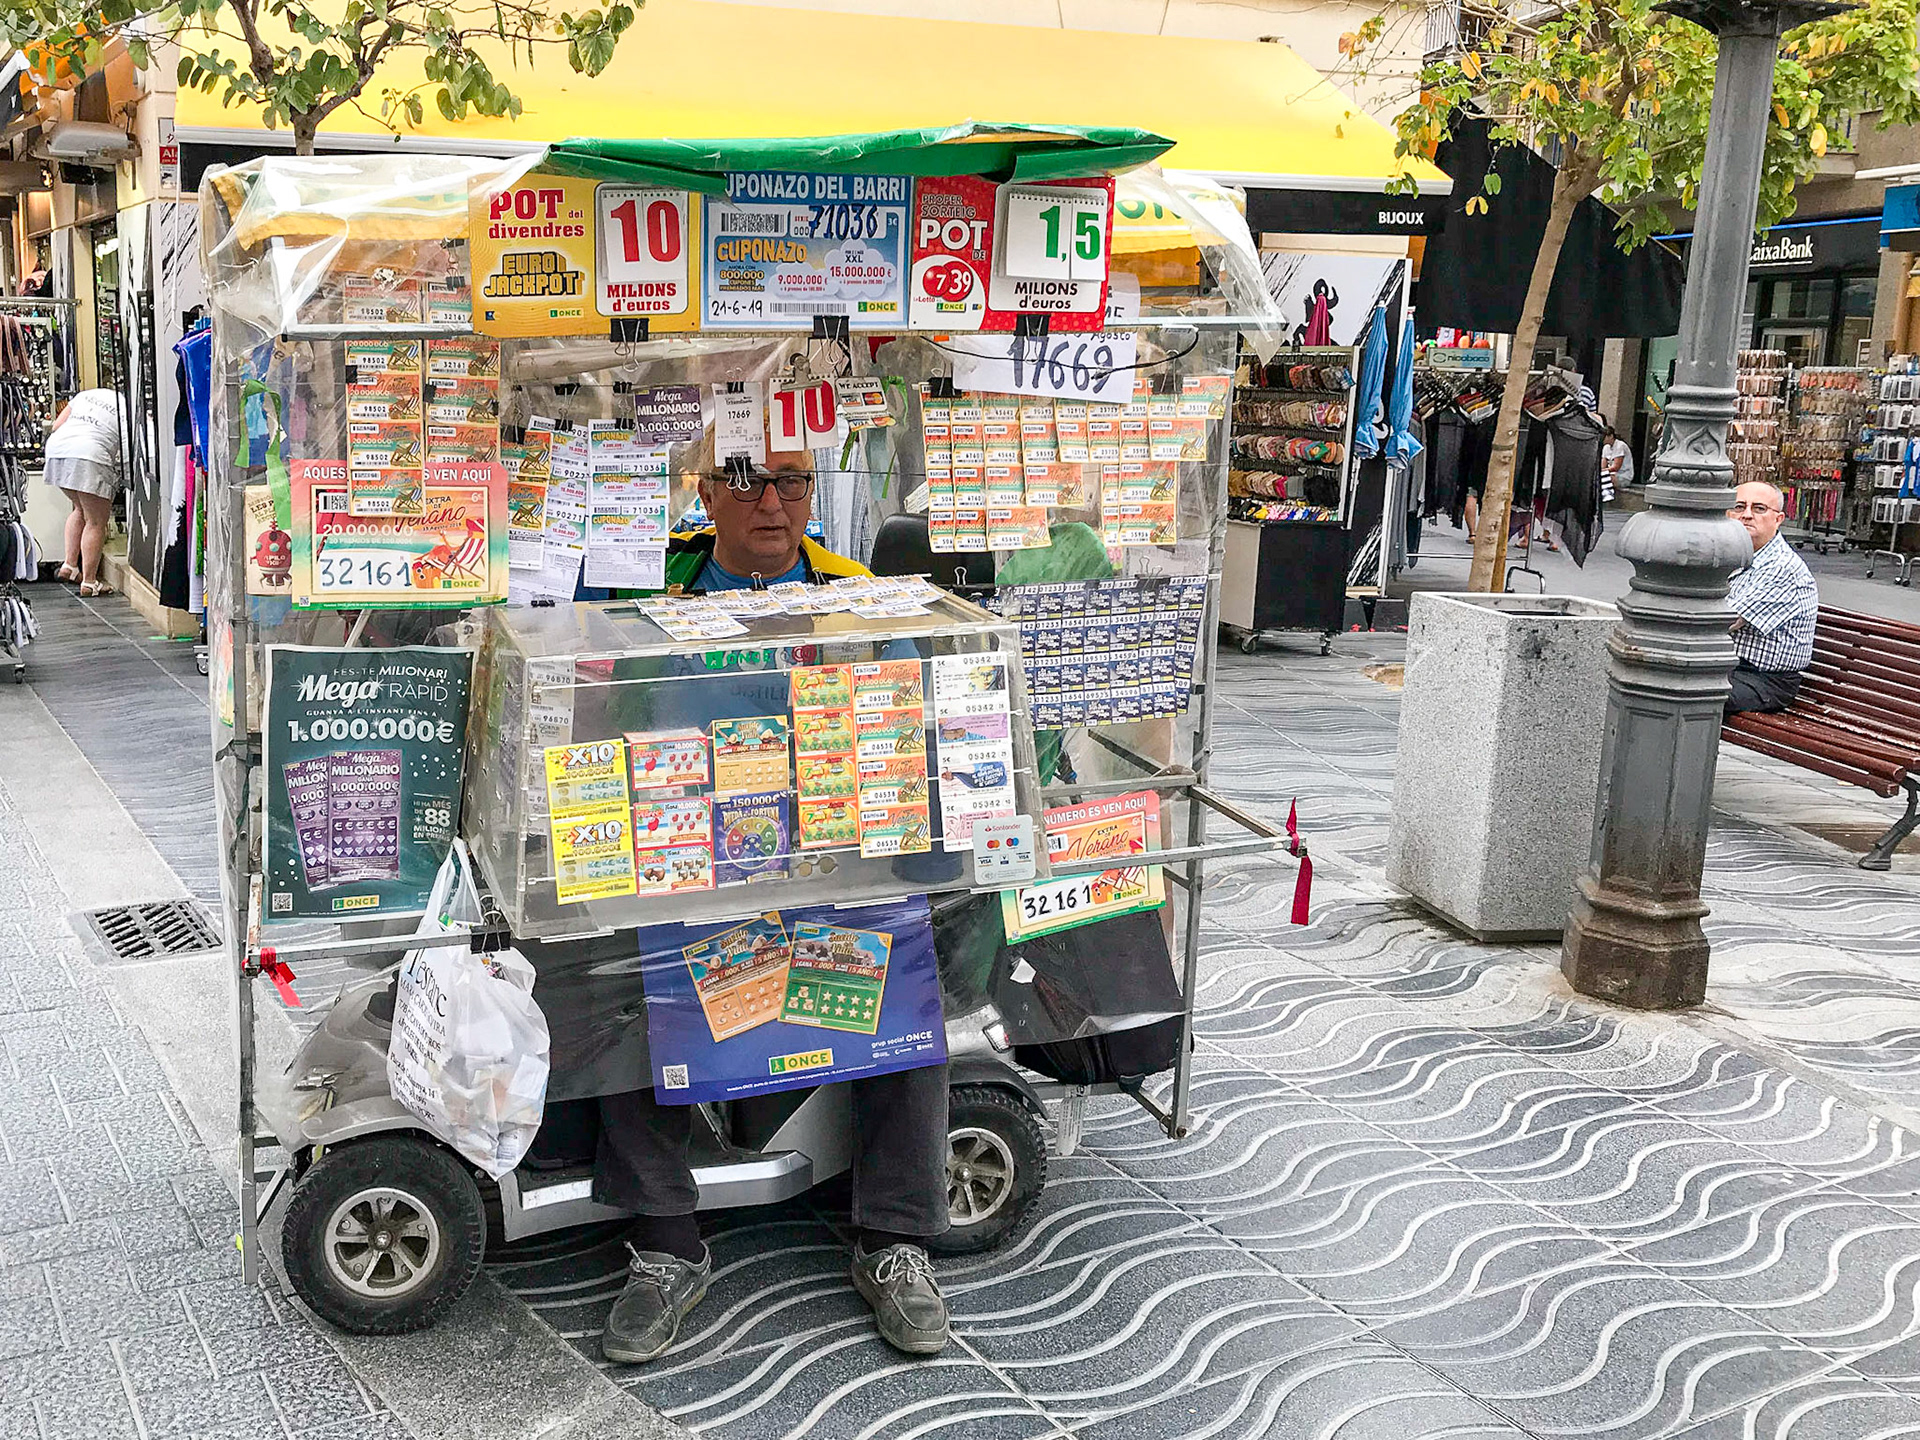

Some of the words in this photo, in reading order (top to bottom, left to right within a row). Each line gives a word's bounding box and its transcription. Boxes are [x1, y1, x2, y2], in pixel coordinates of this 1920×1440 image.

[815, 175, 847, 200] DEL
[853, 176, 906, 201] BARRI
[489, 188, 564, 220] POT
[568, 209, 584, 219] del
[921, 194, 963, 206] PROPER
[921, 205, 977, 219] SORTEIG
[1378, 211, 1425, 225] BIJOUX
[808, 203, 878, 241] 71036
[488, 223, 585, 240] divendres
[610, 199, 681, 263] 10
[919, 218, 988, 250] POT
[1039, 205, 1101, 266] 1,5
[717, 238, 808, 264] CUPONAZO
[971, 249, 986, 261] DE
[502, 252, 559, 276] EURO
[845, 255, 863, 263] XXL
[719, 269, 765, 280] 800.000
[830, 266, 885, 278] 15.000.000
[483, 272, 580, 298] JACKPOT
[777, 275, 822, 285] 9.000.000
[935, 273, 946, 290] 7
[949, 268, 972, 294] 39
[607, 282, 677, 299] MILIONS
[1014, 282, 1079, 296] MILIONS
[612, 299, 671, 312] d'euros
[711, 300, 764, 317] 21-6-19
[869, 302, 896, 312] ONCE
[1019, 295, 1072, 310] d'euros
[362, 356, 385, 365] 98502
[1006, 335, 1113, 398] 17669
[838, 381, 852, 390] WE
[852, 381, 879, 390] ACCEPT
[653, 390, 682, 404] Mega
[636, 402, 701, 416] MILLONARIO
[727, 410, 751, 420] 17669
[773, 379, 836, 438] 10
[638, 420, 702, 433] 1.000.000€
[591, 430, 630, 441] CUPONAZO
[366, 454, 388, 462] 98502
[303, 466, 347, 480] AQUES
[433, 469, 458, 481] VEN
[461, 464, 492, 483] AQUÍ
[632, 463, 659, 472] 71036
[425, 495, 452, 505] EXTRA
[554, 508, 581, 521] 90271
[631, 504, 658, 513] 71036
[592, 513, 630, 523] CUPONAZO
[319, 556, 413, 589] 32161
[454, 580, 480, 588] ONCE
[1036, 621, 1060, 630] 01233
[1085, 618, 1108, 626] 69515
[726, 650, 774, 667] ONCE
[963, 656, 992, 669] 05342
[1035, 658, 1060, 667] 01233
[1084, 654, 1108, 663] 69515
[333, 667, 375, 677] FES-TE
[378, 665, 448, 679] MILIONARI
[545, 674, 571, 685] 96870
[297, 673, 378, 709] Mega
[388, 680, 449, 702] RÀPID
[868, 694, 891, 703] 06538
[1035, 696, 1060, 704] 01233
[305, 709, 345, 718] GUANYA
[940, 708, 948, 716] 5€
[965, 704, 994, 717] 05342
[287, 717, 456, 744] 1.000.000€
[351, 754, 381, 767] Mega
[567, 742, 615, 768] X10
[968, 752, 997, 765] 05342
[305, 760, 328, 774] Meg
[331, 764, 400, 777] MILLONARIO
[331, 781, 400, 794] 1.000.000€
[874, 790, 896, 800] 06538
[432, 799, 452, 810] MÉS
[972, 800, 1001, 814] 05342
[424, 808, 451, 828] 88
[1043, 807, 1087, 829] NÚMERO
[1088, 805, 1101, 818] ES
[1102, 802, 1123, 816] VEN
[1124, 794, 1147, 812] AQUÍ
[574, 820, 622, 845] X10
[992, 824, 1022, 832] Santander
[1097, 824, 1118, 837] EXTRA
[876, 840, 899, 849] 06538
[1066, 827, 1130, 861] Verano
[1121, 887, 1143, 902] ONCE
[346, 896, 379, 908] ONCE
[1023, 884, 1092, 919] 32161
[871, 1040, 886, 1052] grup
[887, 1036, 906, 1046] social
[906, 1030, 934, 1044] ONCE
[788, 1052, 829, 1068] ONCE
